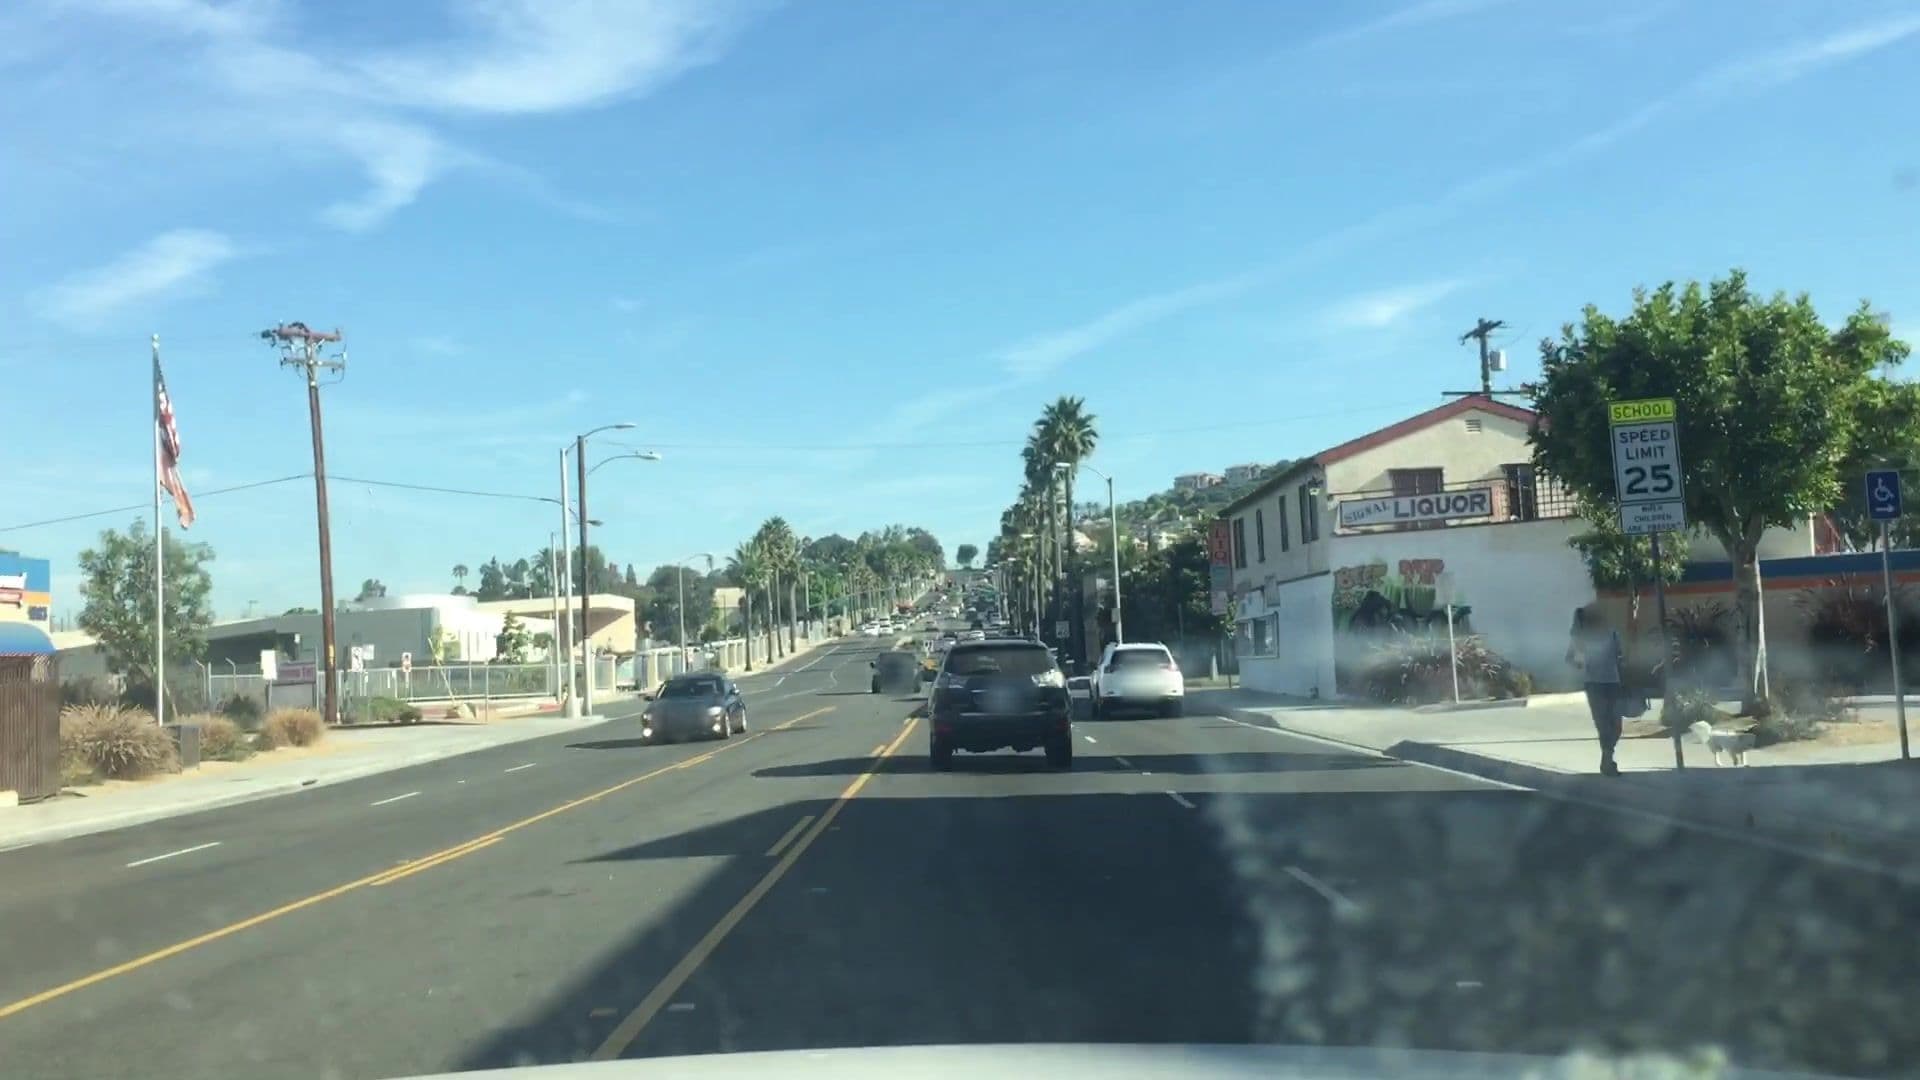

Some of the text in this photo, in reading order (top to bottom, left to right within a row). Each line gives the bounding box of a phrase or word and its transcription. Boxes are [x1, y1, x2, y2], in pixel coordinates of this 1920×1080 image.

[1613, 404, 1671, 418] SCHOOL
[1619, 430, 1670, 443] SPEED
[1625, 446, 1665, 460] LIMIT
[1624, 464, 1673, 494] 25
[1393, 493, 1486, 518] LIQUOR
